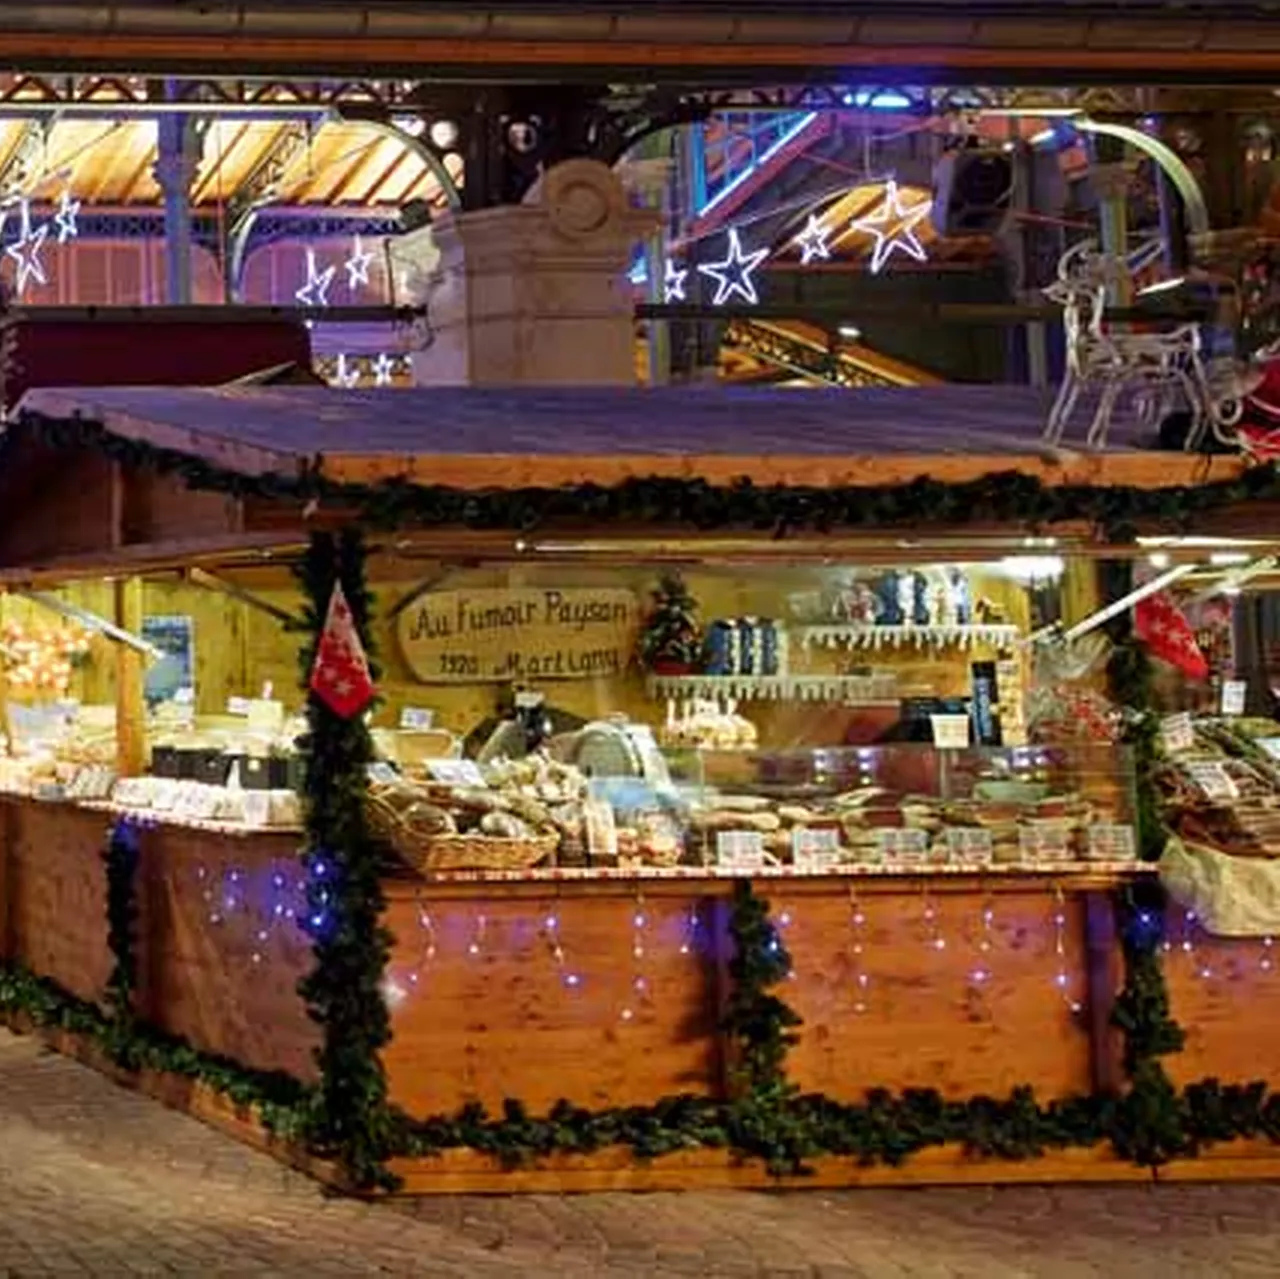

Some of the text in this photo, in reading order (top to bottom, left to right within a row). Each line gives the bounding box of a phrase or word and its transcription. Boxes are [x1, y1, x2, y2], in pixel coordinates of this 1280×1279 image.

[409, 590, 627, 640] Au Fumoir Paysan
